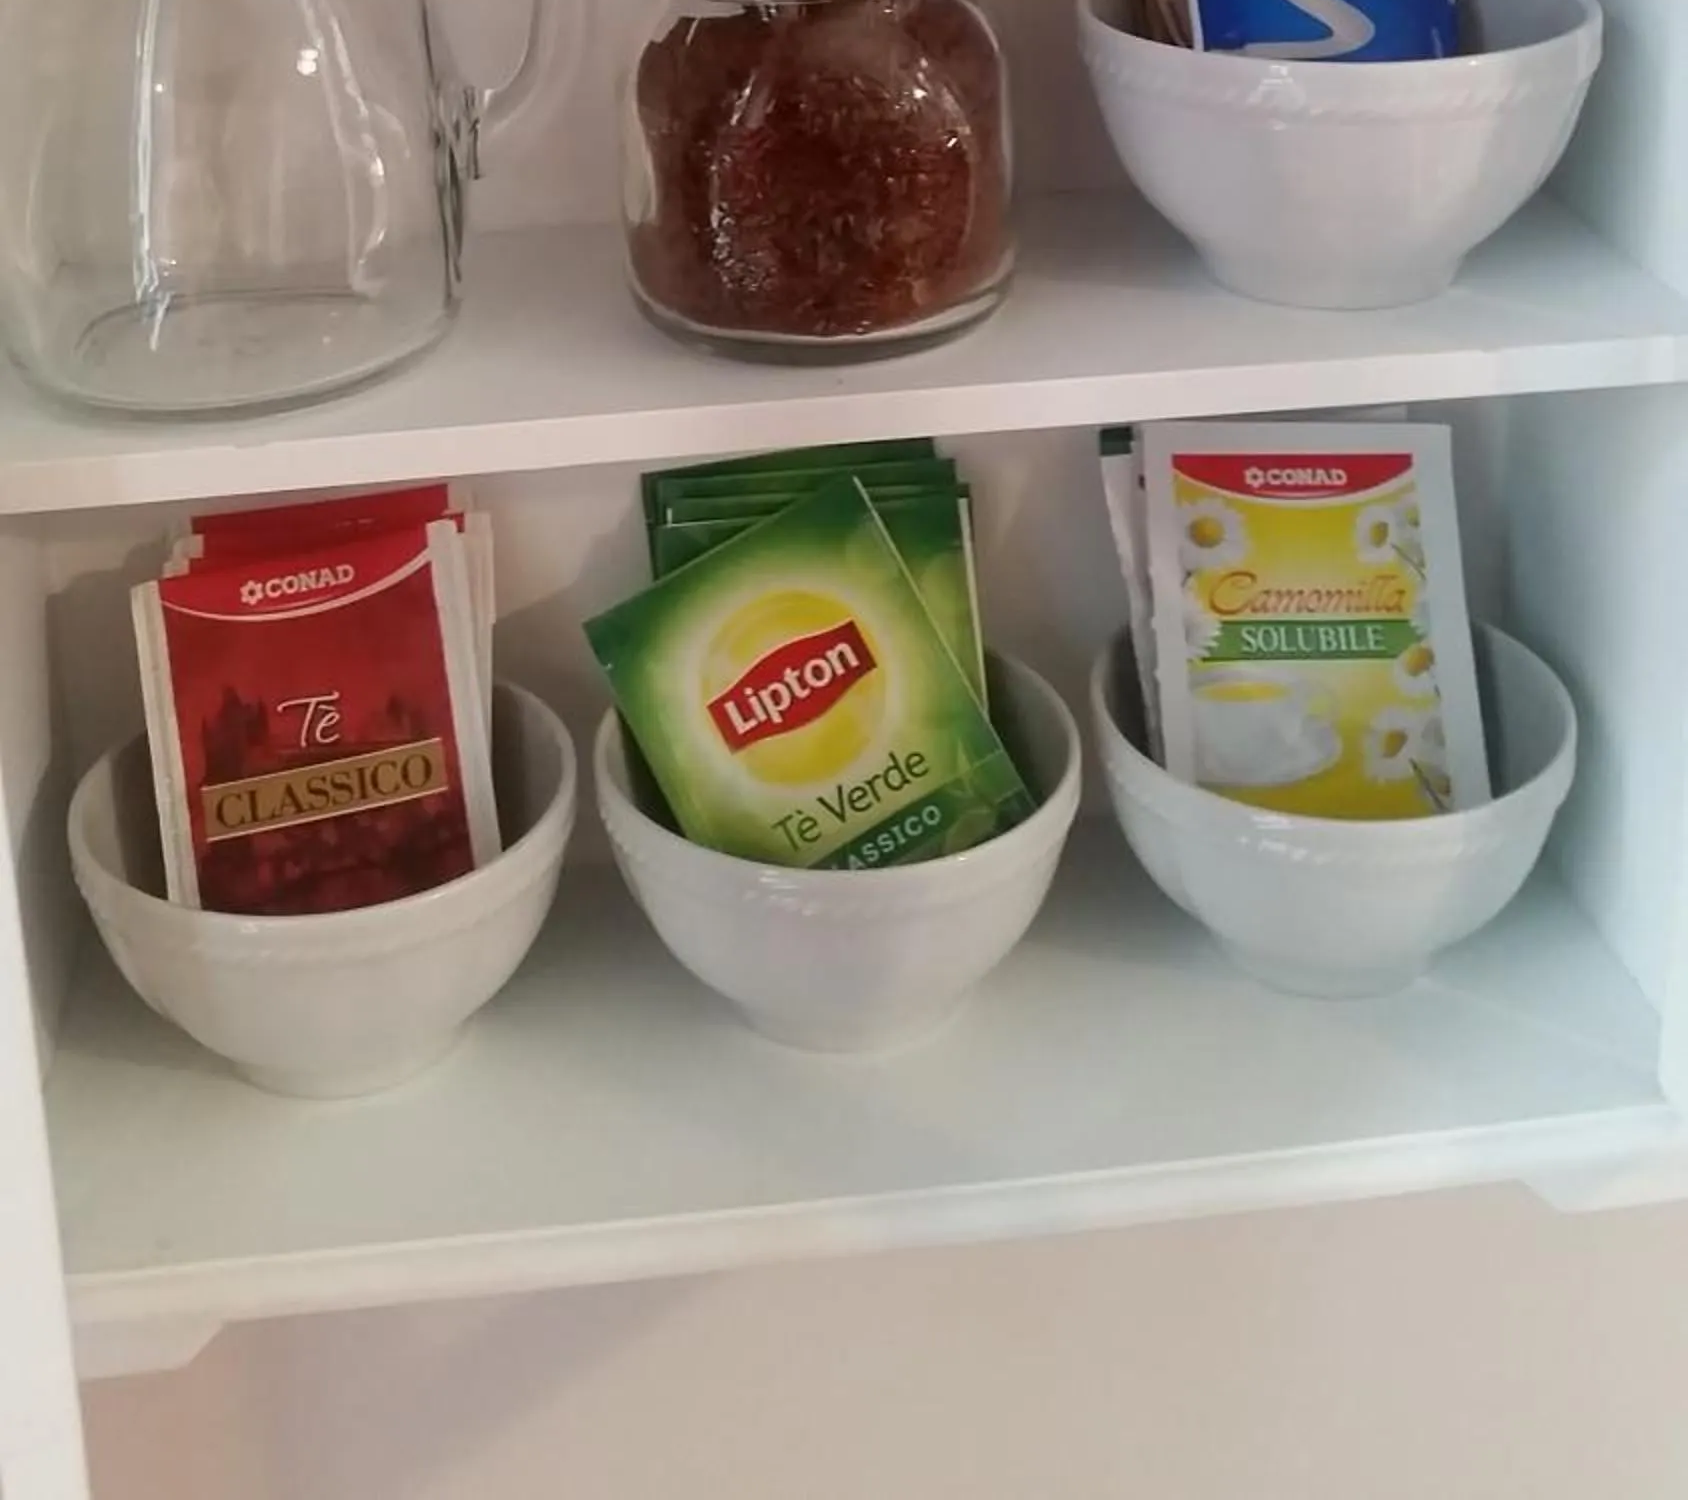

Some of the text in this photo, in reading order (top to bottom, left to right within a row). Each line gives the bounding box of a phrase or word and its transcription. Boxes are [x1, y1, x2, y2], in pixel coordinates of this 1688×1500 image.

[1265, 468, 1347, 486] CONAD
[264, 563, 355, 599] CONAD
[1209, 570, 1407, 615] Camomilla
[1240, 624, 1387, 653] SOLUBILE
[723, 639, 860, 736] Lipton
[276, 690, 341, 749] Tè
[214, 753, 433, 830] CLASSICO
[772, 751, 930, 852] Tè Verde
[832, 804, 942, 870] ASSICO
